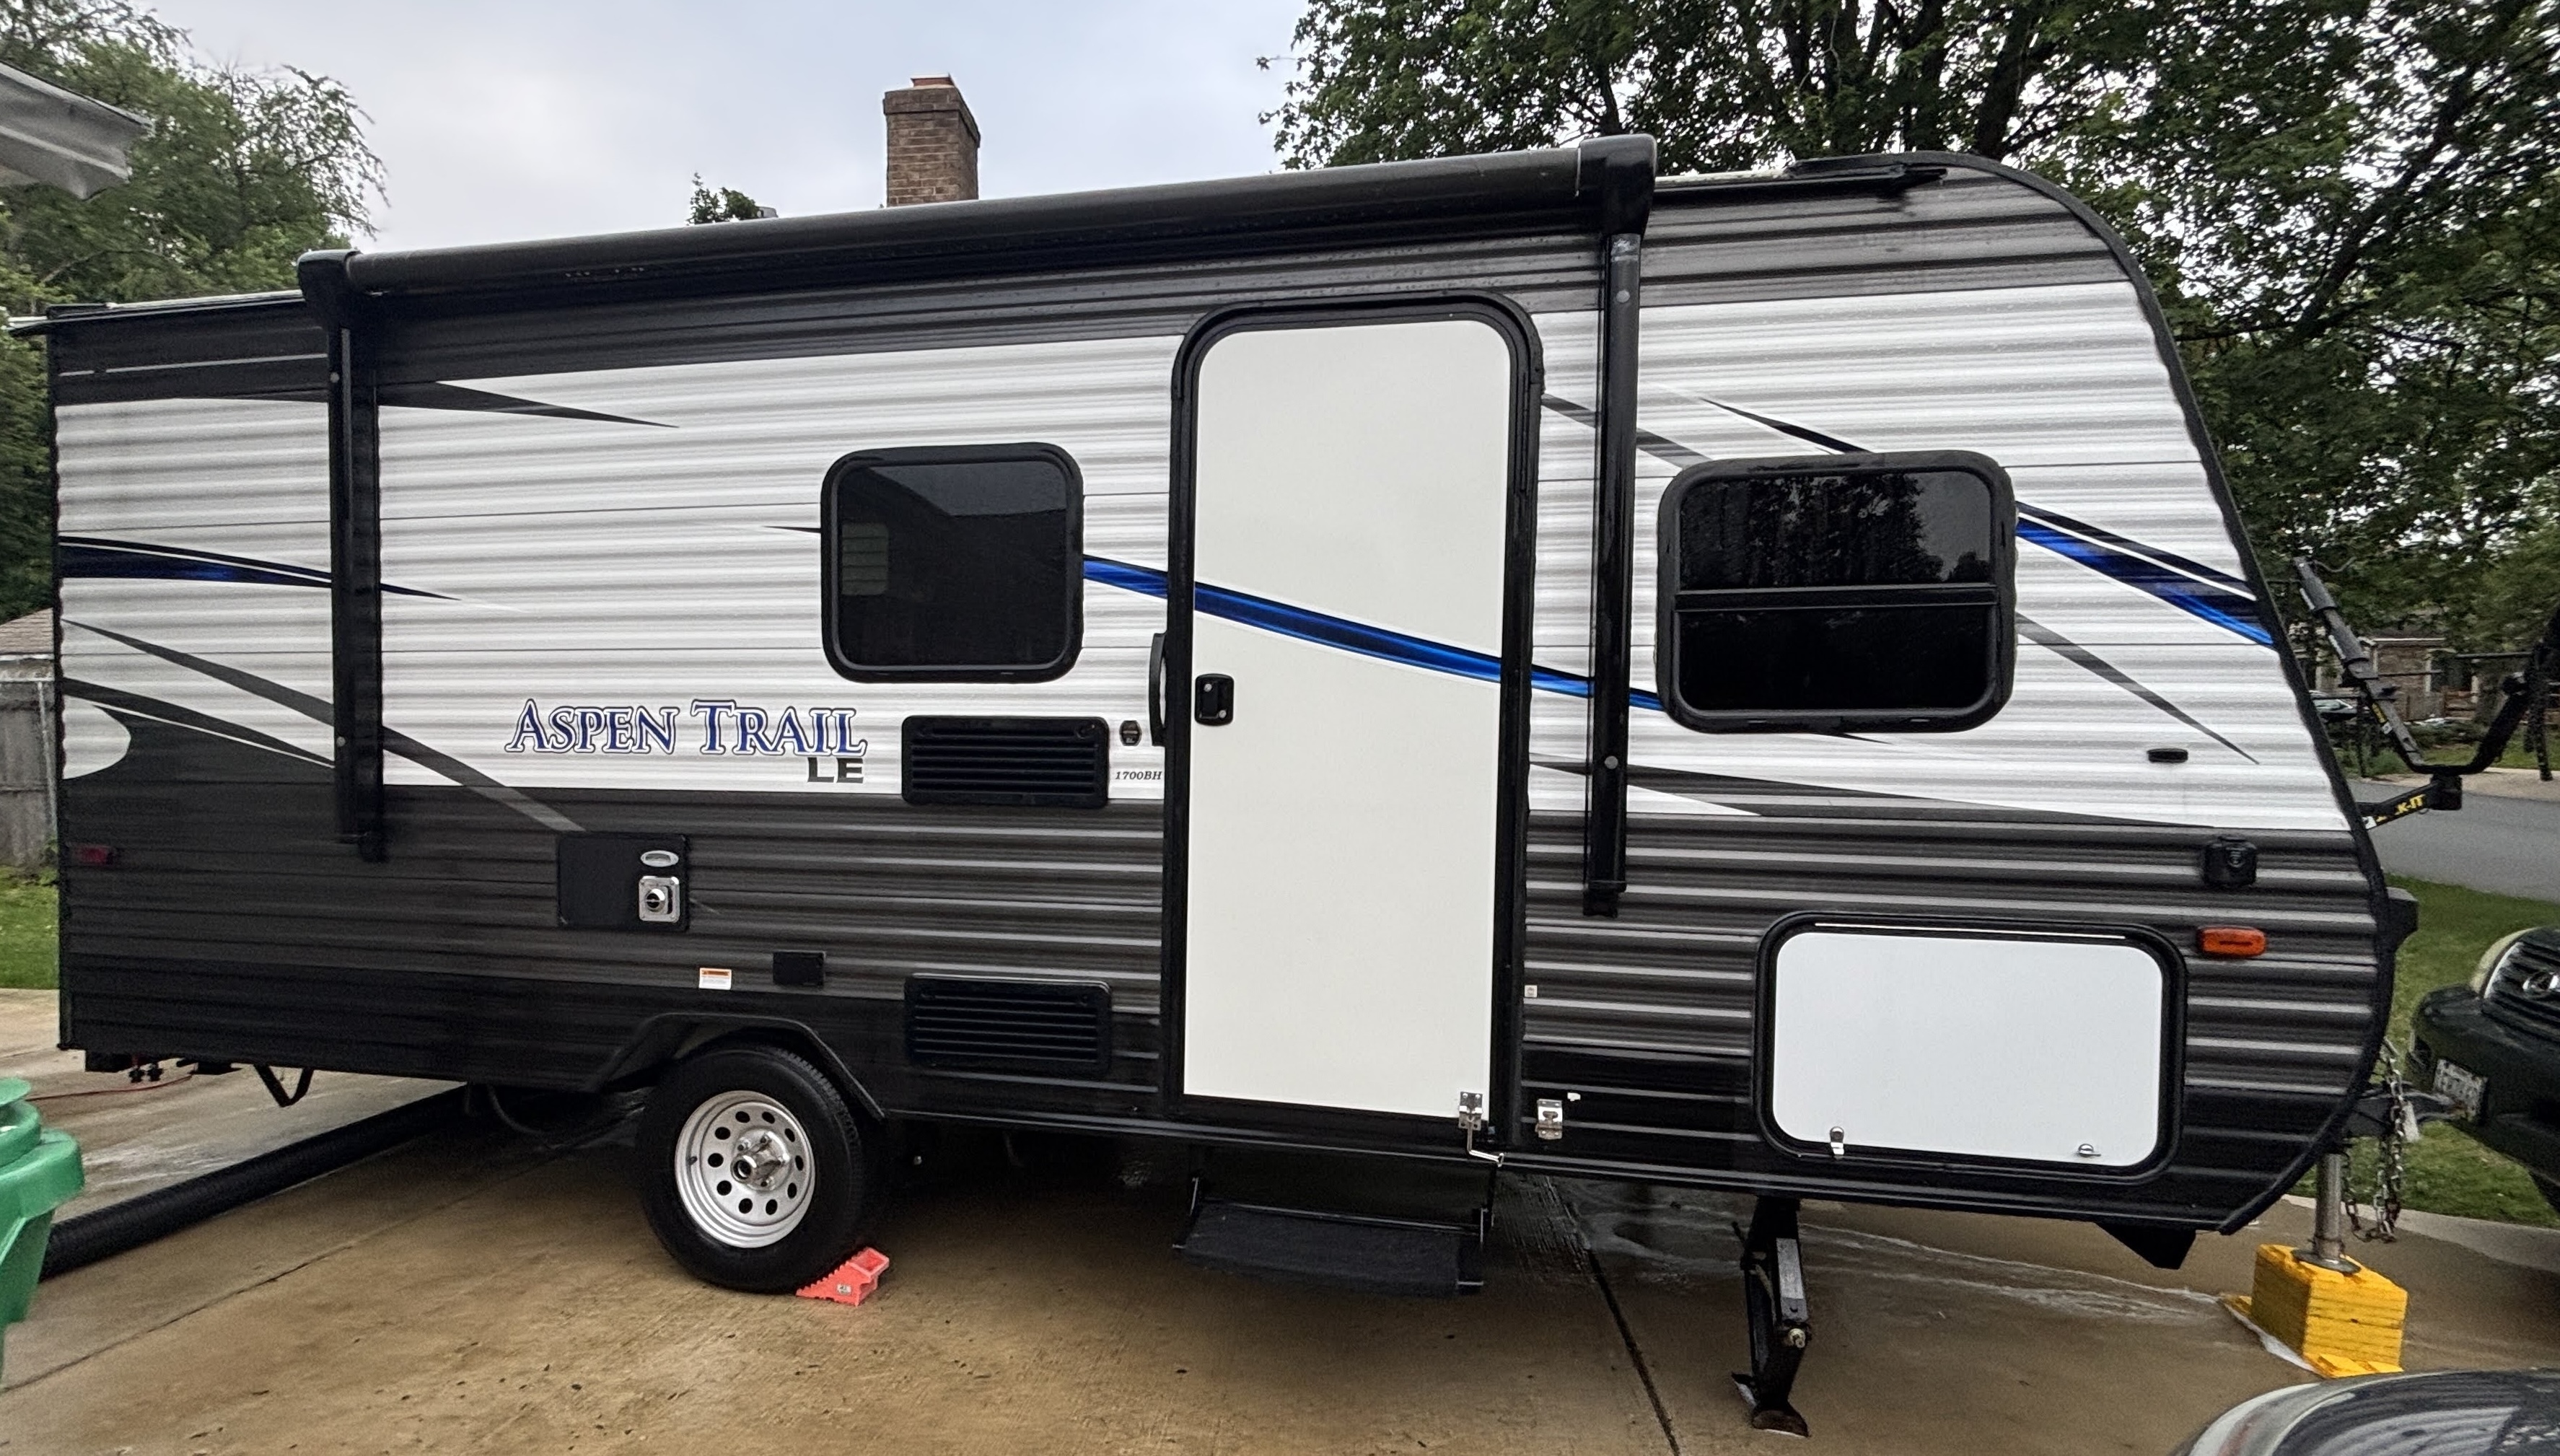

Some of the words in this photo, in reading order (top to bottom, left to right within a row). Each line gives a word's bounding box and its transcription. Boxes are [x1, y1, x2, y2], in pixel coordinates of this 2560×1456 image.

[505, 698, 679, 754] ASPEN
[691, 699, 867, 756] TRAIL
[807, 757, 864, 783] LE
[1115, 771, 1162, 780] 1700BH
